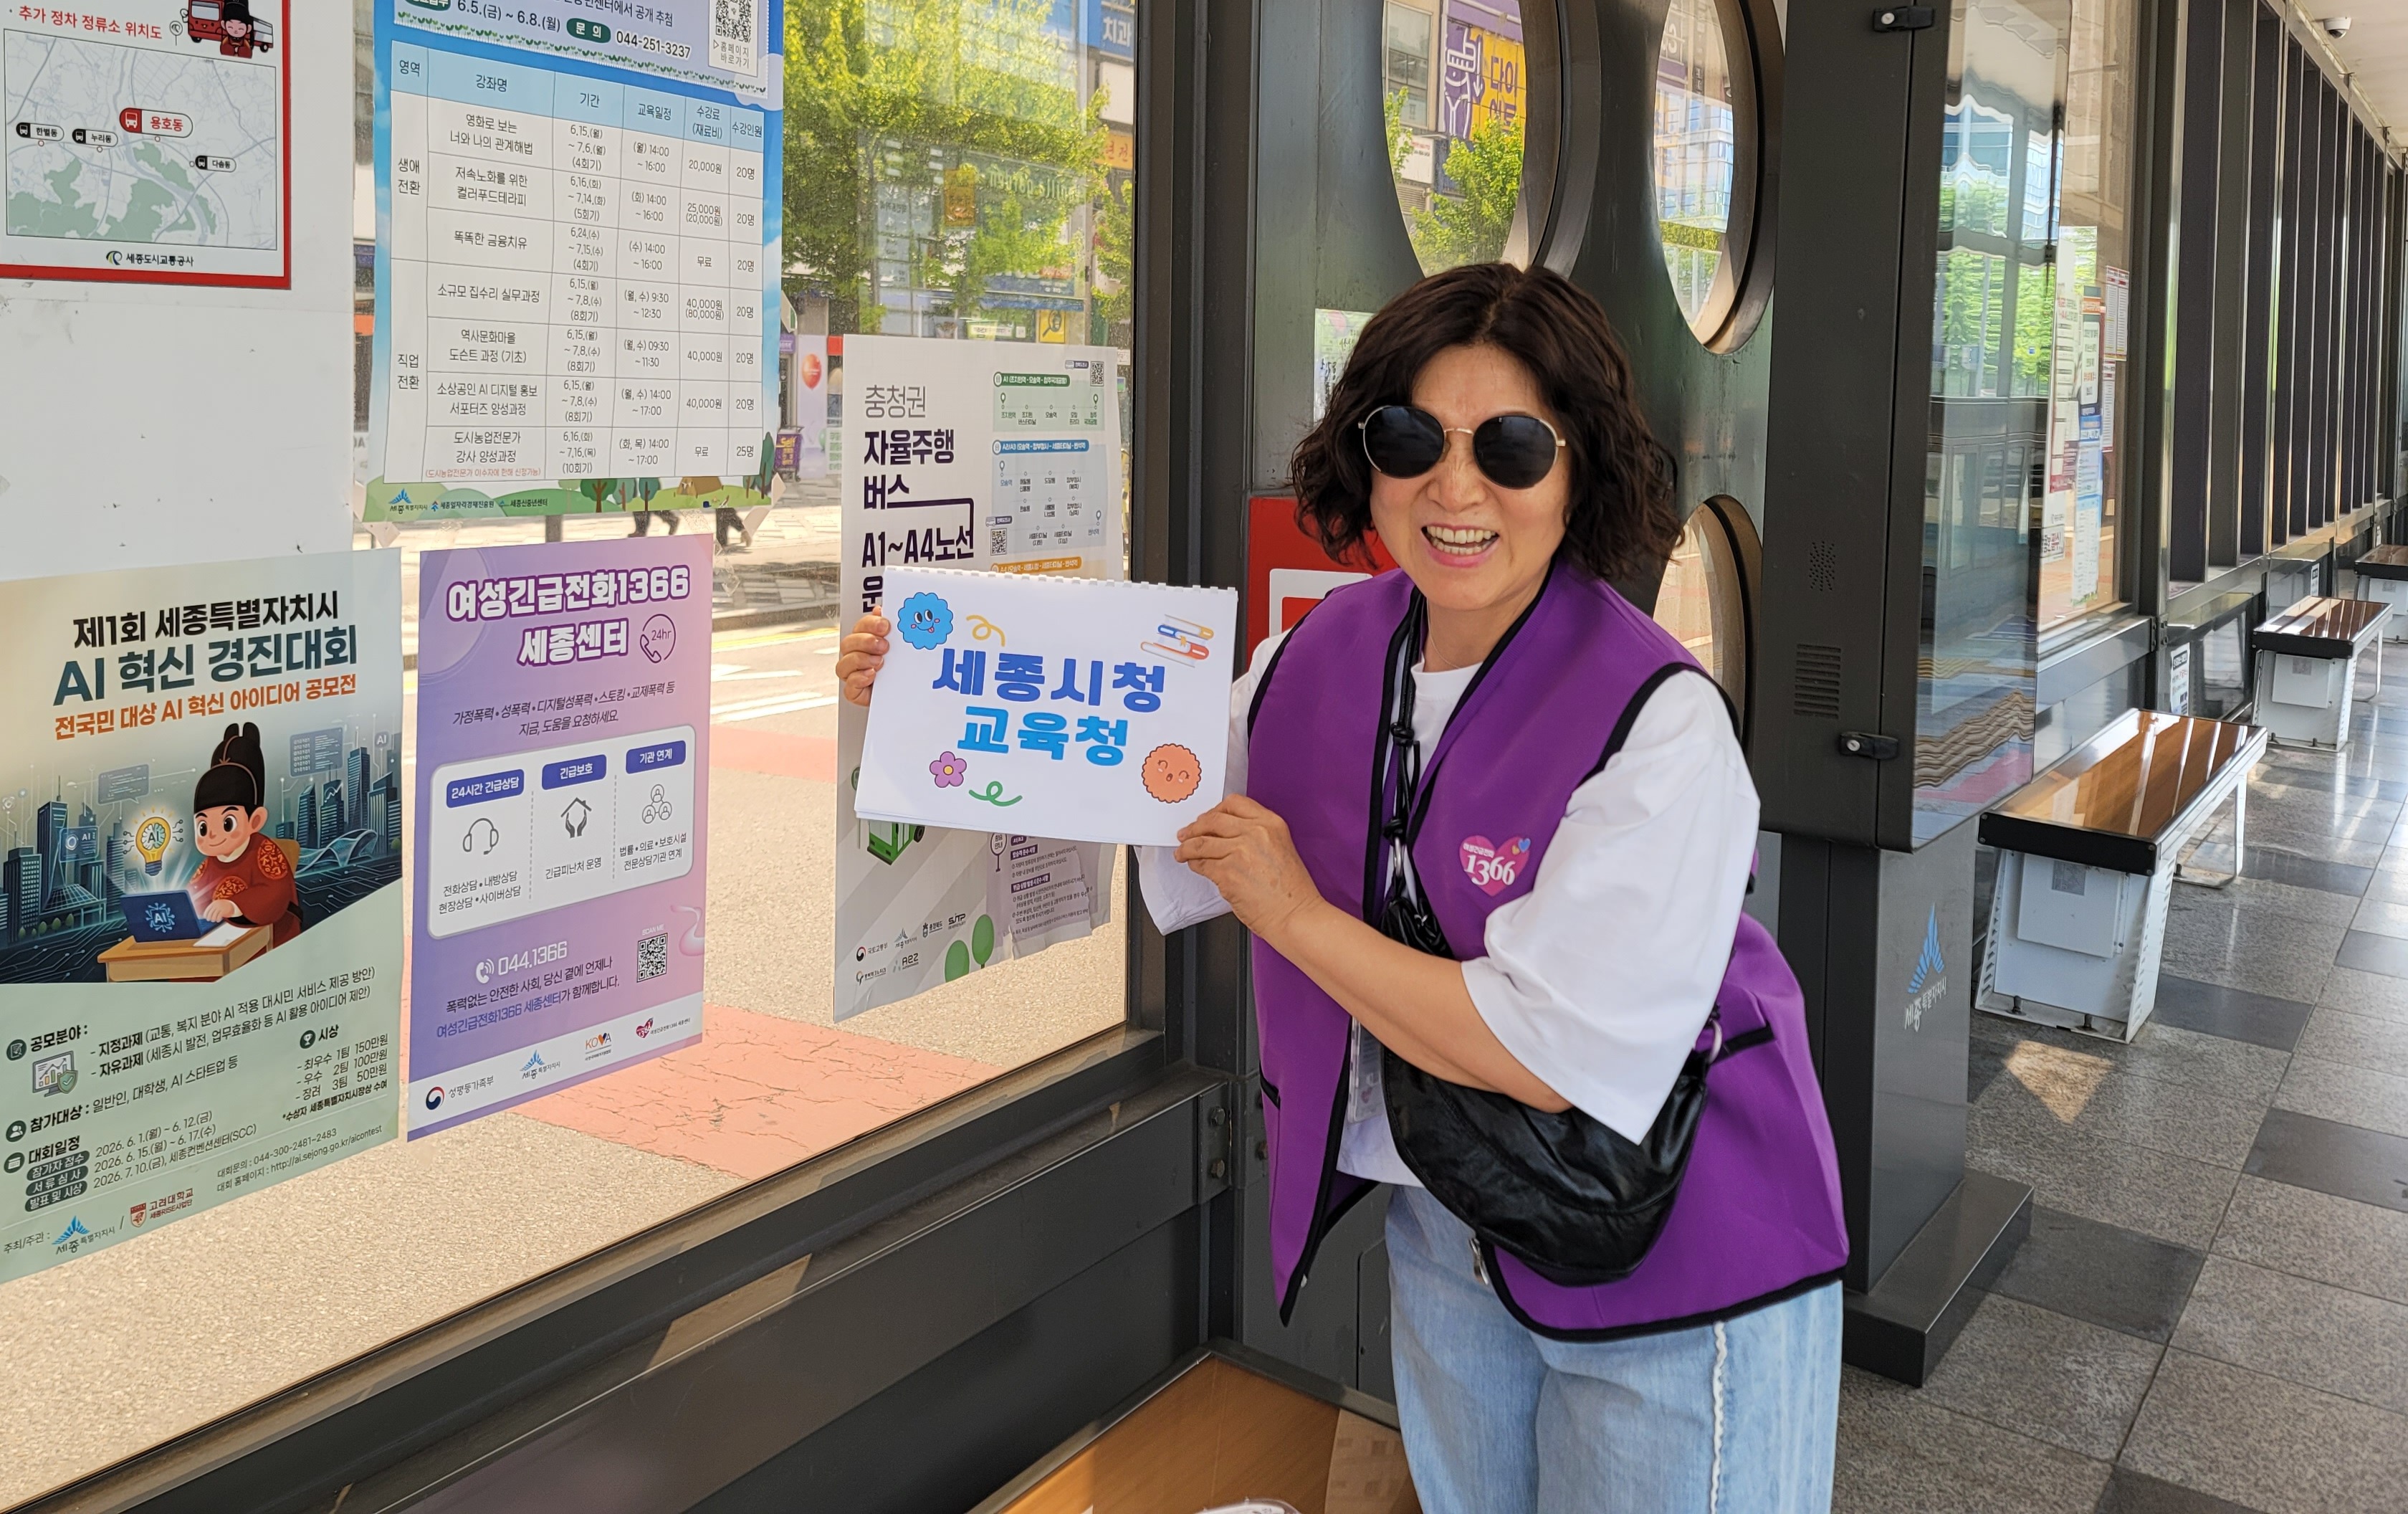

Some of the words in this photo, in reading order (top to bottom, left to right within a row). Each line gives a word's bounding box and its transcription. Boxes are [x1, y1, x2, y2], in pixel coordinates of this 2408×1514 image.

[19, 6, 46, 24] 추가
[51, 10, 77, 28] 정차
[82, 14, 121, 34] 정류소
[125, 22, 163, 39] 위치도
[457, 0, 502, 21] 6.5.(금)
[517, 10, 560, 32] 6.8.(월)
[635, 5, 654, 23] 공개
[656, 10, 673, 27] 추첨
[616, 30, 691, 59] 044-251-3237
[720, 41, 750, 57] 홈페이지
[399, 59, 421, 77] 영역
[720, 54, 750, 70] 바로가기
[475, 74, 507, 92] 강좌명
[579, 92, 600, 108] 기간
[637, 103, 672, 121] 교육일정
[696, 105, 720, 120] 수강료
[150, 116, 183, 132] 용호동
[466, 114, 494, 130] 영화로
[498, 120, 517, 134] 보는
[570, 125, 603, 139] 6.15.(월)
[692, 123, 722, 139] (재료비)
[732, 123, 763, 138] 수강인원
[450, 130, 470, 146] 너와
[474, 134, 492, 149] 나의
[494, 138, 533, 155] 관계해법
[398, 158, 420, 173] 생애
[573, 157, 602, 171] (4회기)
[689, 159, 722, 174] 20,000원
[455, 166, 505, 184] 저속노화를
[509, 173, 527, 188] 위한
[737, 167, 755, 181] 20명
[398, 179, 421, 196] 전환
[457, 186, 527, 206] 컬러푸드테라피
[454, 230, 484, 246] 똑똑한
[487, 234, 527, 249] 금융치유
[126, 252, 194, 267] 세종도시교통공사
[697, 257, 712, 267] 무료
[438, 284, 467, 298] 소규모
[469, 285, 498, 300] 집수리
[502, 287, 540, 303] 실무과정
[687, 298, 722, 310] 40,000원
[461, 329, 516, 345] 역사문화마을
[398, 353, 419, 368] 직업
[449, 348, 478, 362] 도슨트
[480, 350, 499, 363] 과정
[502, 350, 527, 363] (기초)
[397, 375, 419, 390] 전환
[437, 382, 476, 396] 소상공인
[479, 384, 488, 395] AI
[491, 384, 517, 396] 디지털
[521, 384, 538, 397] 홍보
[449, 402, 488, 416] 서포터즈
[491, 403, 526, 416] 양성과정
[865, 385, 926, 418] 충청권
[454, 431, 521, 444] 도시농업전문가
[864, 429, 954, 465] 자율주행
[457, 450, 475, 464] 강사
[479, 450, 516, 463] 양성과정
[694, 447, 709, 457] 무료
[736, 445, 754, 457] 25명
[864, 475, 910, 510] 버스
[861, 525, 974, 568] A1~A4노선
[446, 566, 690, 622] 여성긴급전화1366
[73, 611, 145, 649] 제1회
[156, 590, 338, 639] 세종특별자치시
[518, 619, 629, 665] 세종센터
[651, 628, 672, 641] 24hr
[53, 657, 105, 706] AI
[118, 644, 195, 693] 혁신
[209, 624, 357, 682] 경진대회
[932, 648, 1166, 713] 세종시청
[55, 709, 115, 740] 전국민
[120, 703, 157, 728] 대상
[161, 698, 183, 722] AI
[188, 692, 224, 717] 혁신
[230, 681, 300, 710] 아이디어
[306, 673, 356, 700] 공모전
[453, 707, 495, 725] 가정폭력
[501, 702, 530, 719] 성폭력
[537, 693, 593, 713] 디지털성폭력
[598, 688, 626, 704] 스토킹
[631, 684, 665, 699] 교제폭력
[666, 681, 676, 693] 등
[519, 723, 540, 736] 지금,
[543, 716, 571, 732] 도움을
[572, 710, 619, 728] 요청하세요.
[957, 706, 1128, 766] 교육청
[640, 751, 654, 763] 기관
[656, 748, 672, 761] 연계
[560, 763, 593, 779] 긴급보호
[452, 781, 482, 799] 24시간
[484, 777, 520, 794] 긴급상담
[148, 832, 159, 843] AI
[545, 861, 584, 880] 긴급피난처
[586, 857, 601, 870] 운영
[1463, 854, 1516, 885] 1366
[155, 913, 167, 923] AI
[497, 941, 568, 976] 044.1366
[446, 992, 487, 1013] 폭력없는
[489, 984, 519, 1003] 안전한
[521, 976, 542, 992] 사회,
[544, 971, 563, 987] 당신
[565, 965, 583, 981] 곁에
[586, 956, 613, 975] 언제나
[99, 1032, 143, 1057] 지정과제
[145, 1024, 174, 1043] (교통,
[176, 1017, 199, 1032] 복지
[201, 1009, 221, 1027] 분야
[224, 1006, 235, 1021] AI
[238, 999, 259, 1015] 적용
[262, 989, 294, 1009] 대시민
[297, 981, 327, 999] 서비스
[329, 973, 349, 989] 제공
[352, 966, 376, 984] 방안)
[30, 1025, 81, 1052] 공모분야
[318, 1024, 339, 1042] 시상
[304, 1053, 332, 1070] 최우수
[337, 1046, 350, 1060] 1팀
[355, 1034, 388, 1054] 150만원
[30, 1105, 82, 1133] 참가대상
[92, 1091, 129, 1113] 일반인,
[133, 1079, 168, 1100] 대학생,
[171, 1074, 183, 1088] AI
[185, 1059, 225, 1084] 스타트업
[228, 1055, 239, 1068] 등
[449, 1075, 494, 1098] 성평등가족부
[28, 1136, 80, 1163] 대회일정
[217, 1161, 248, 1178] 대회문의
[254, 1128, 337, 1165] 044-300-2481~2483
[217, 1181, 232, 1192] 대회
[234, 1167, 264, 1186] 홈페이지
[149, 1188, 194, 1211] 고려대학교
[4, 1232, 44, 1254] 주최/주관
